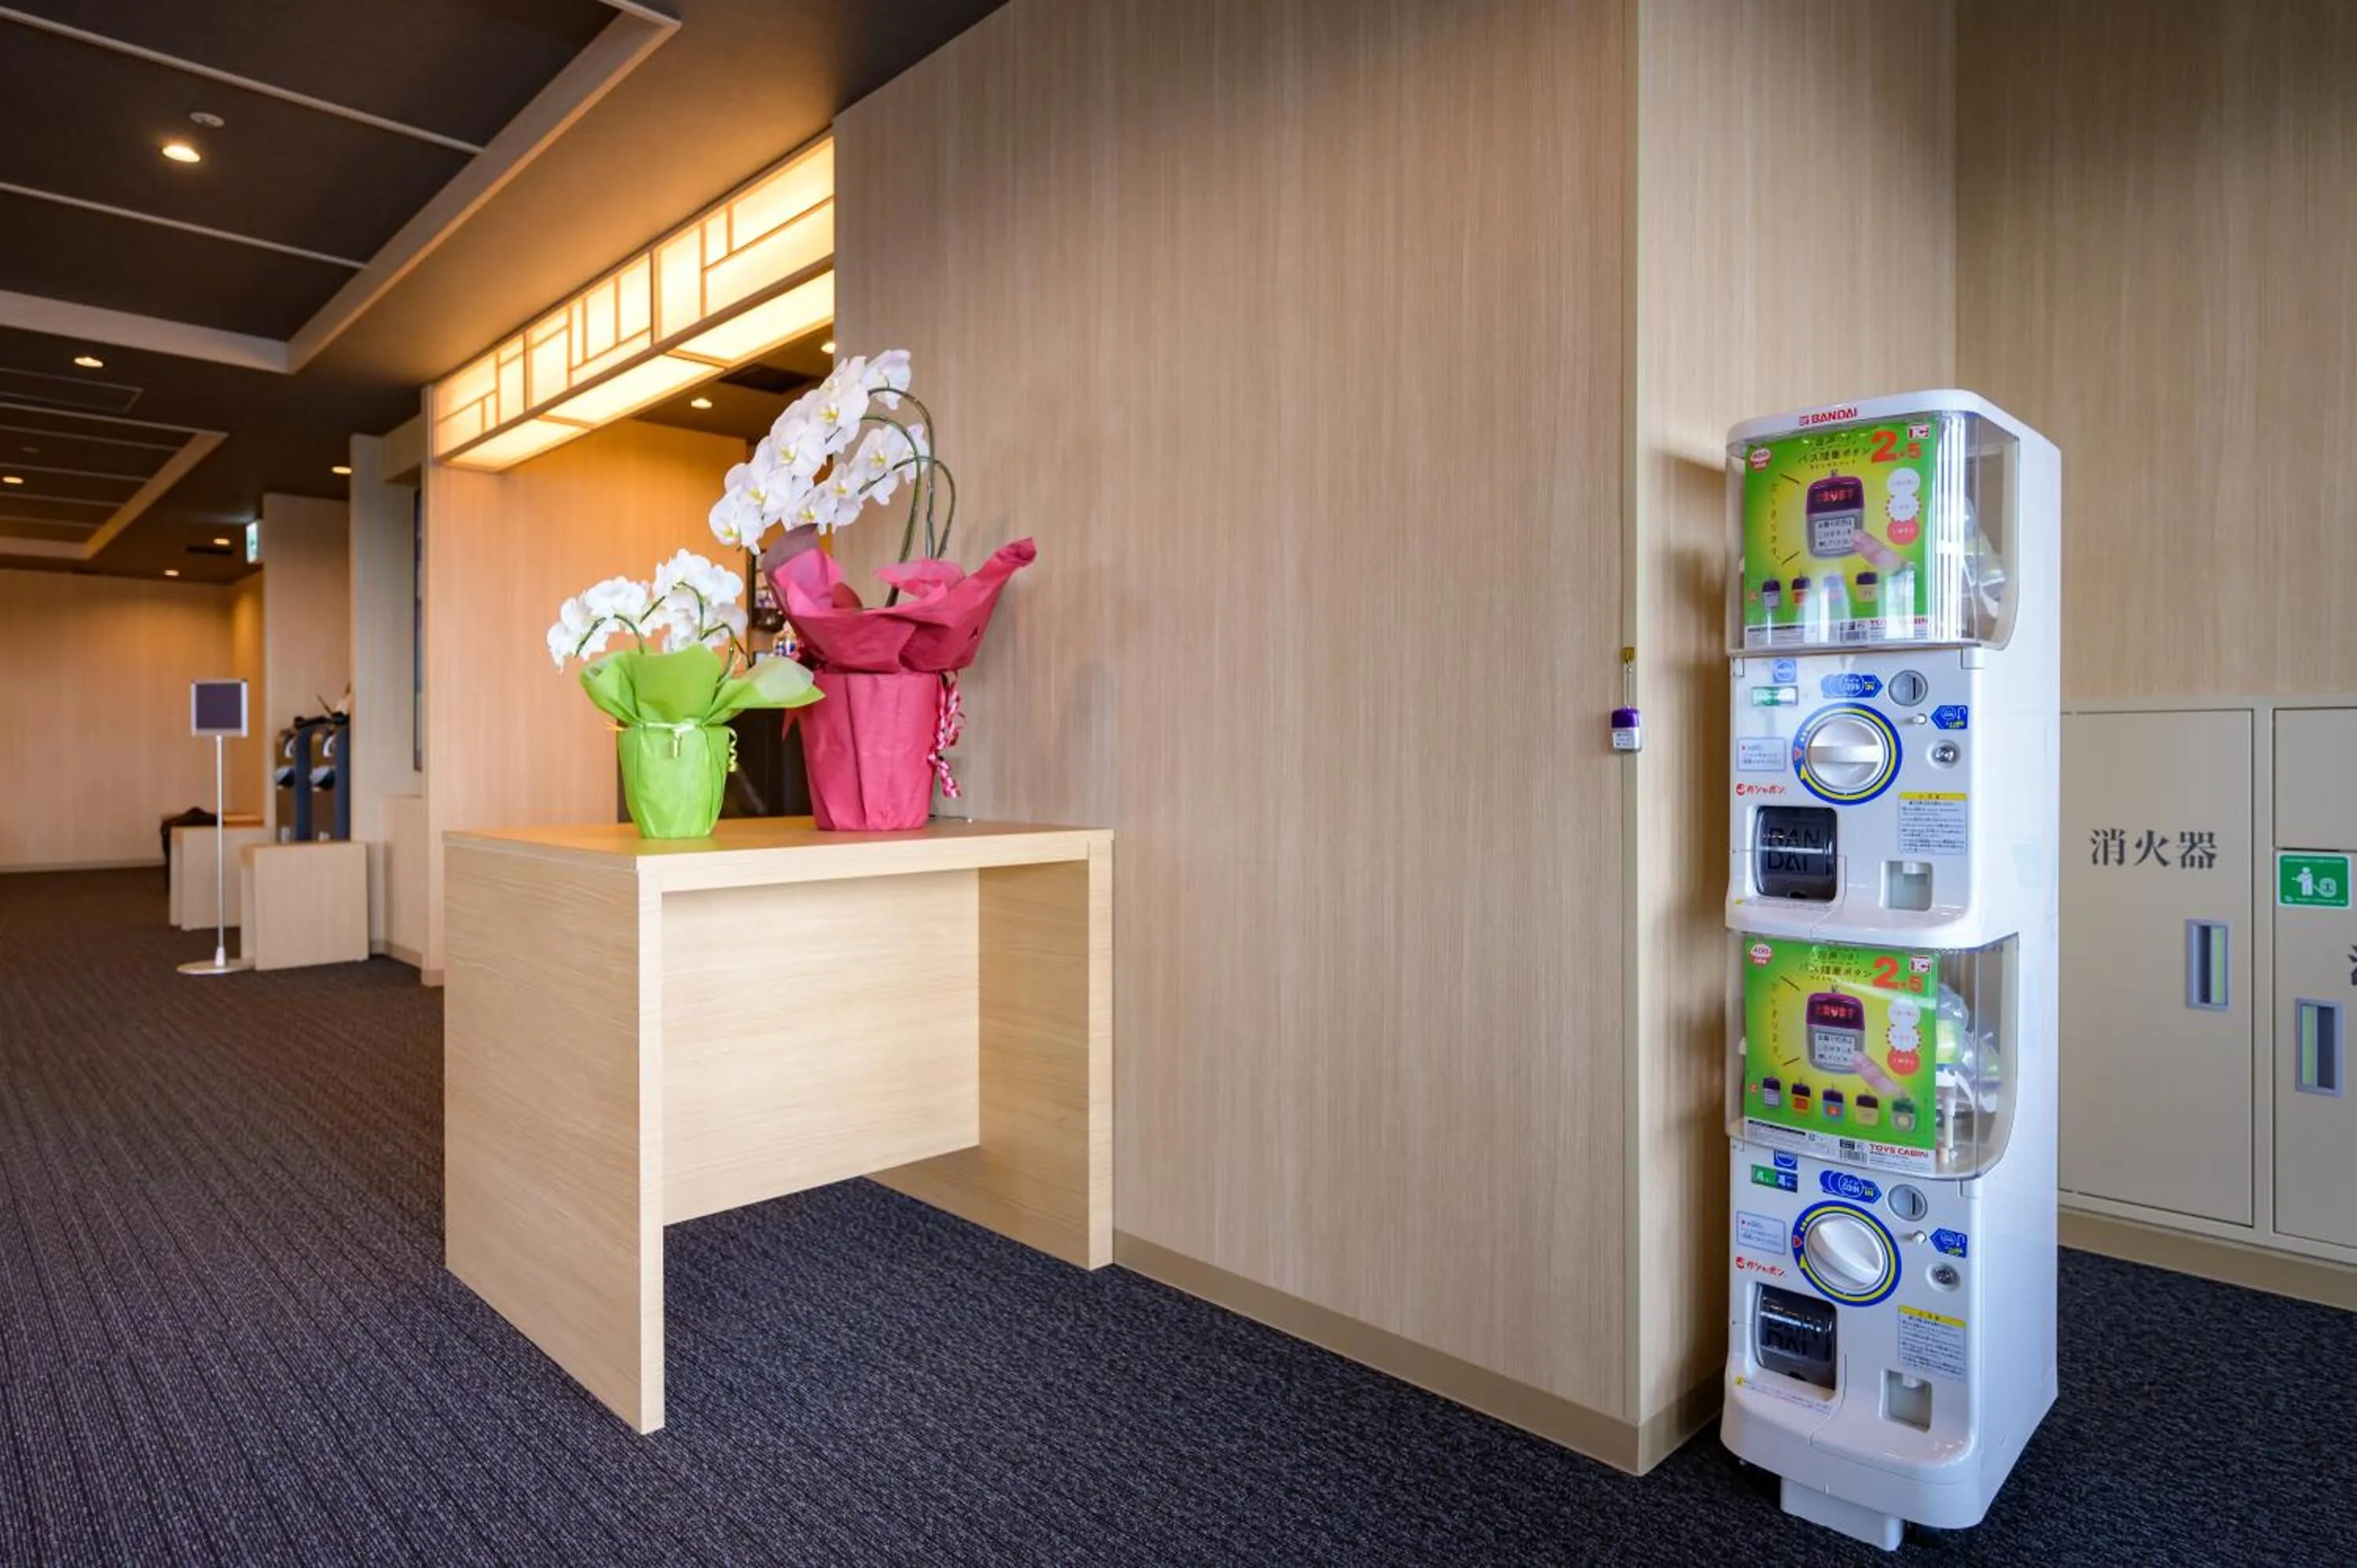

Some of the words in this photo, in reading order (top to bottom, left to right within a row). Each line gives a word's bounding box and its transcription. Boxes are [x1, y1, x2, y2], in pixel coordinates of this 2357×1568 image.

[1811, 408, 1857, 423] BANDAI
[2090, 829, 2217, 870] 消火器
[1869, 1143, 1897, 1154] TOYS
